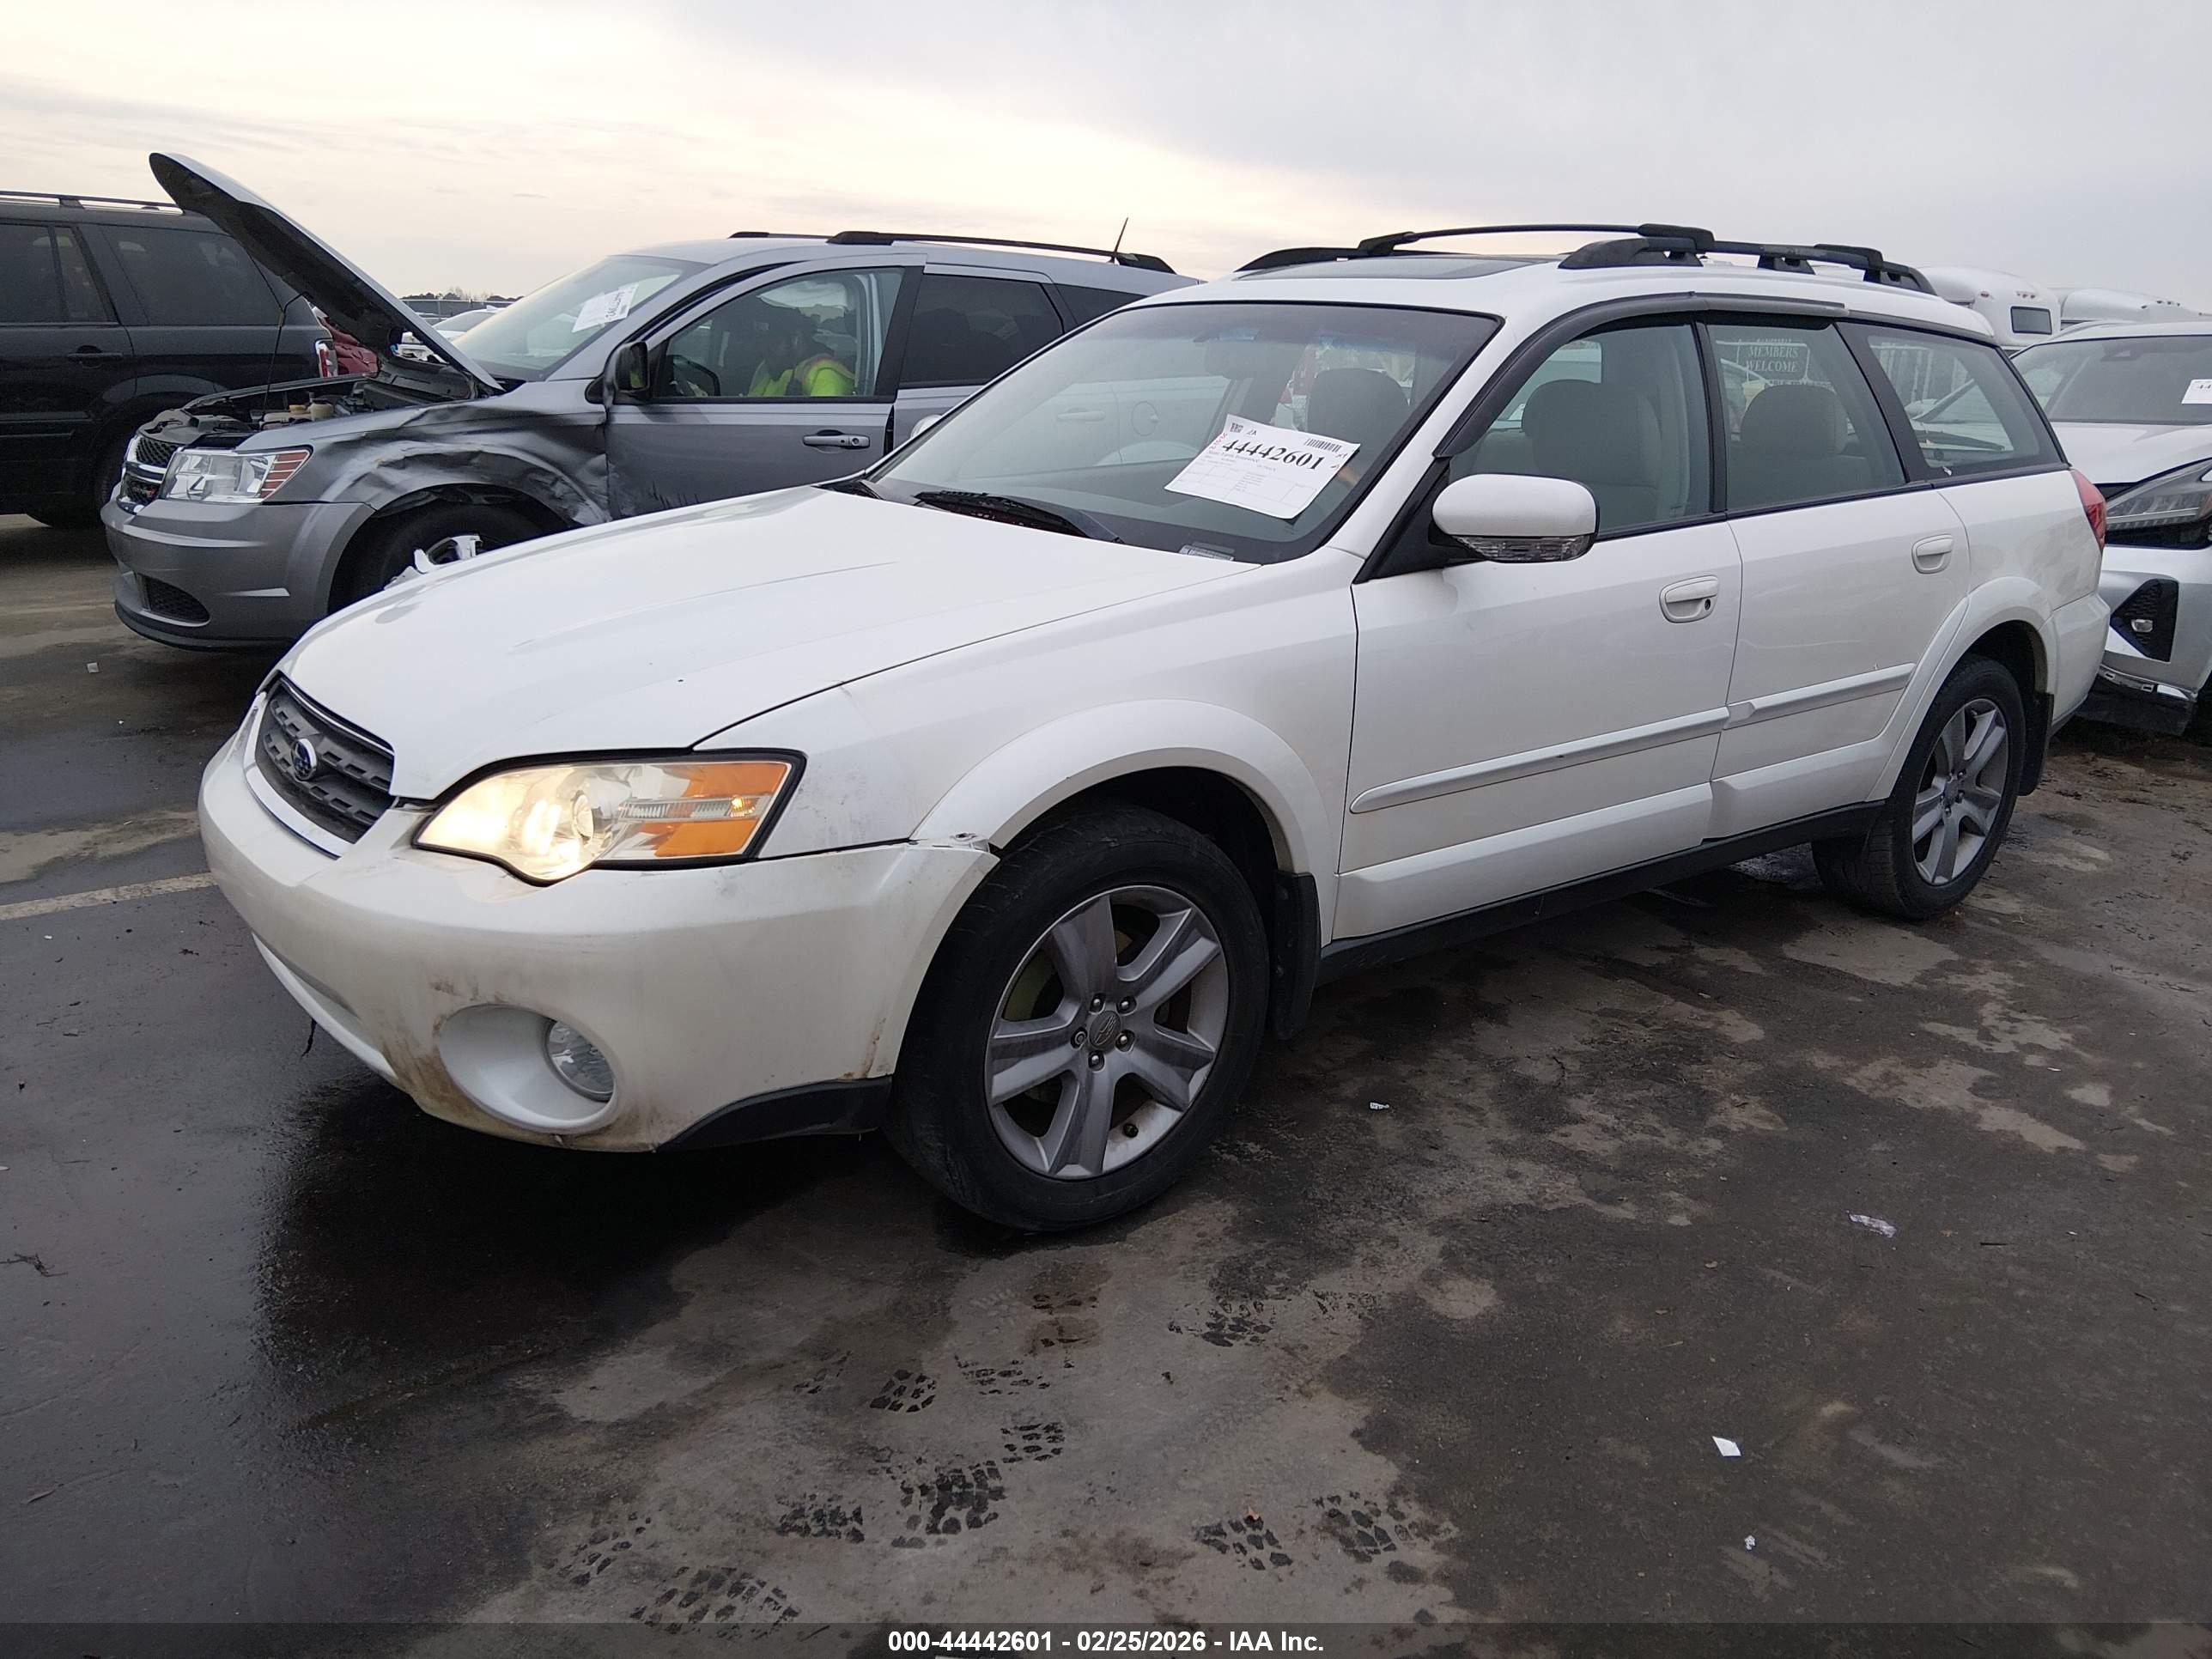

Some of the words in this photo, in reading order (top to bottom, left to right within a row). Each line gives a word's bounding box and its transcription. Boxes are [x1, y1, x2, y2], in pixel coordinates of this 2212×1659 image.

[1747, 346, 1799, 359] MEMBERS
[1746, 361, 1798, 373] WELCOME
[1222, 439, 1325, 471] 44442601
